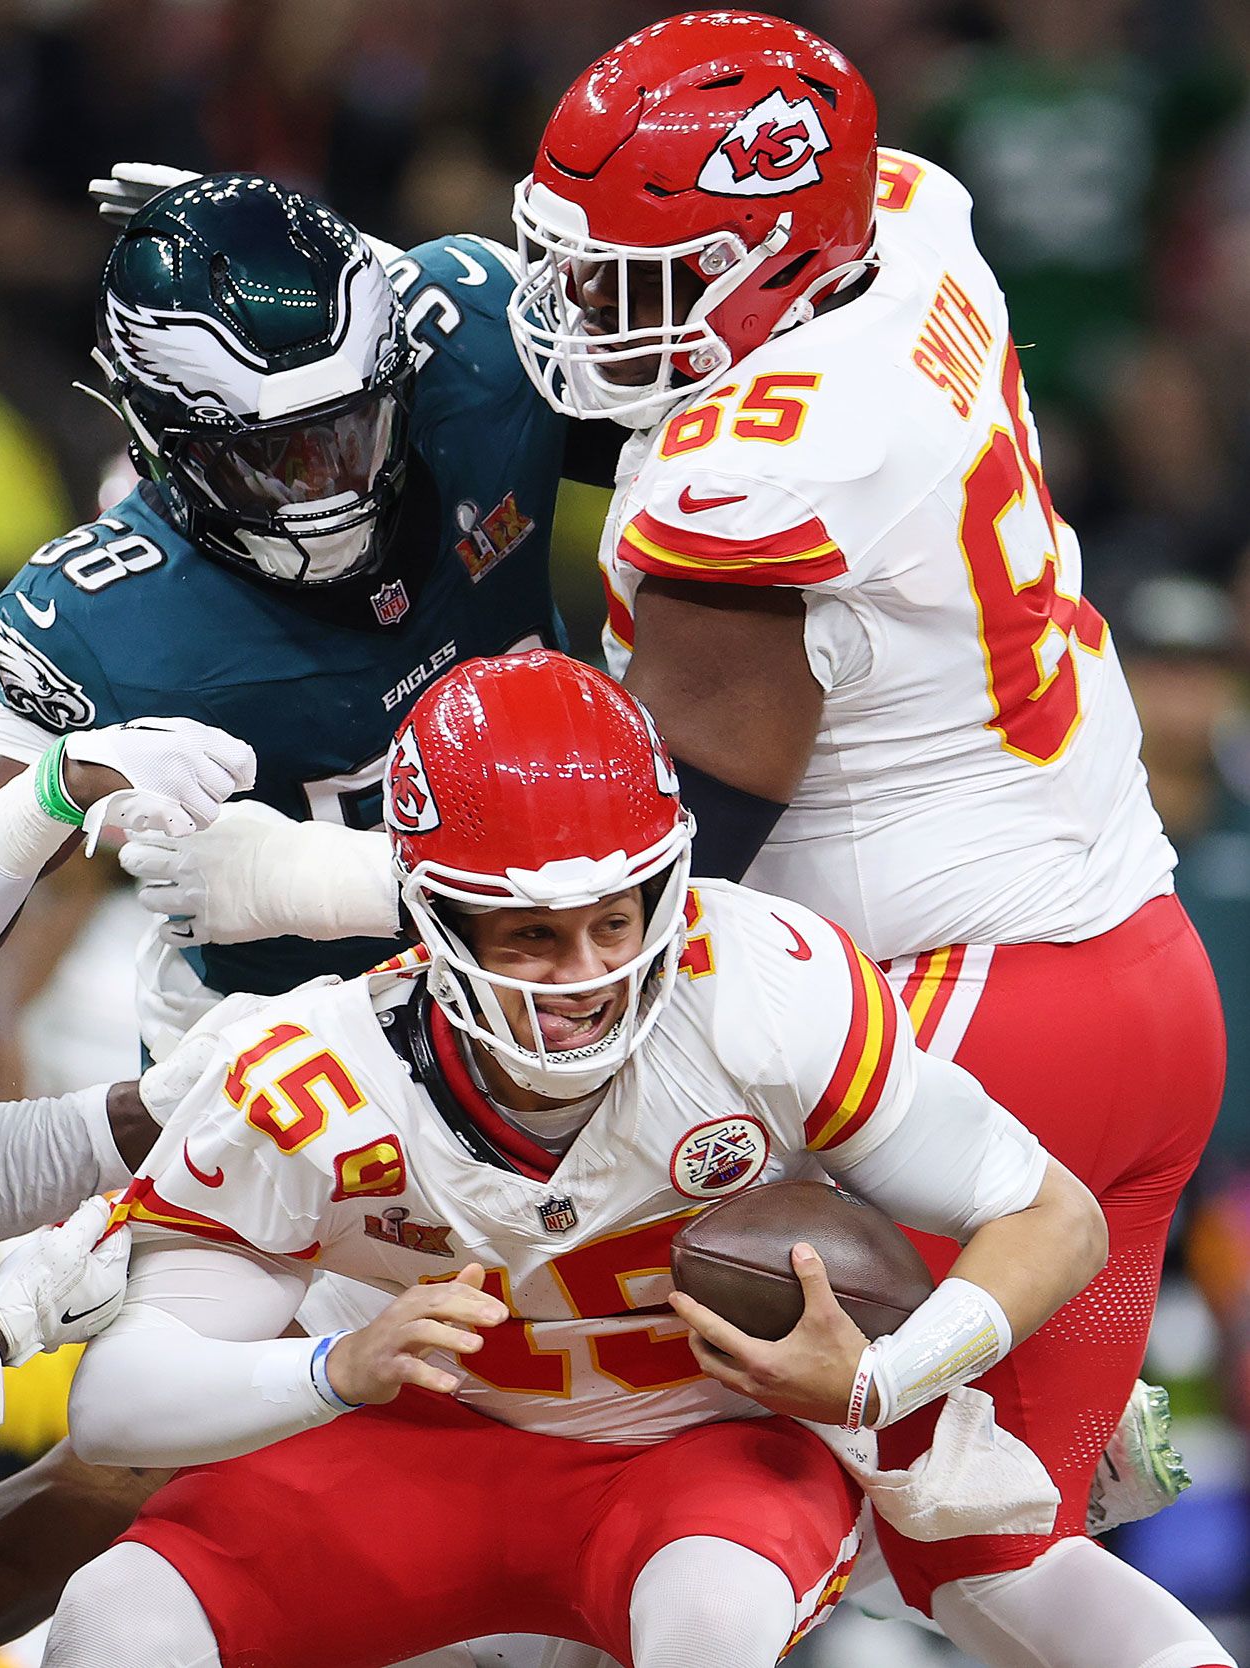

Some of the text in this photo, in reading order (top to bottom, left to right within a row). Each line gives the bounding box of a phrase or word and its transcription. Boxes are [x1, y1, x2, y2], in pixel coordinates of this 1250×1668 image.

[720, 120, 815, 183] KC
[912, 272, 995, 421] SMITH
[189, 415, 235, 426] OAKLEY
[657, 366, 825, 462] 65
[28, 518, 169, 594] 58
[379, 597, 405, 620] NFL
[381, 639, 458, 713] EAGLES
[390, 744, 429, 829] KC
[221, 1020, 369, 1157] 15
[544, 1209, 575, 1231] NFL
[418, 1205, 730, 1400] 15
